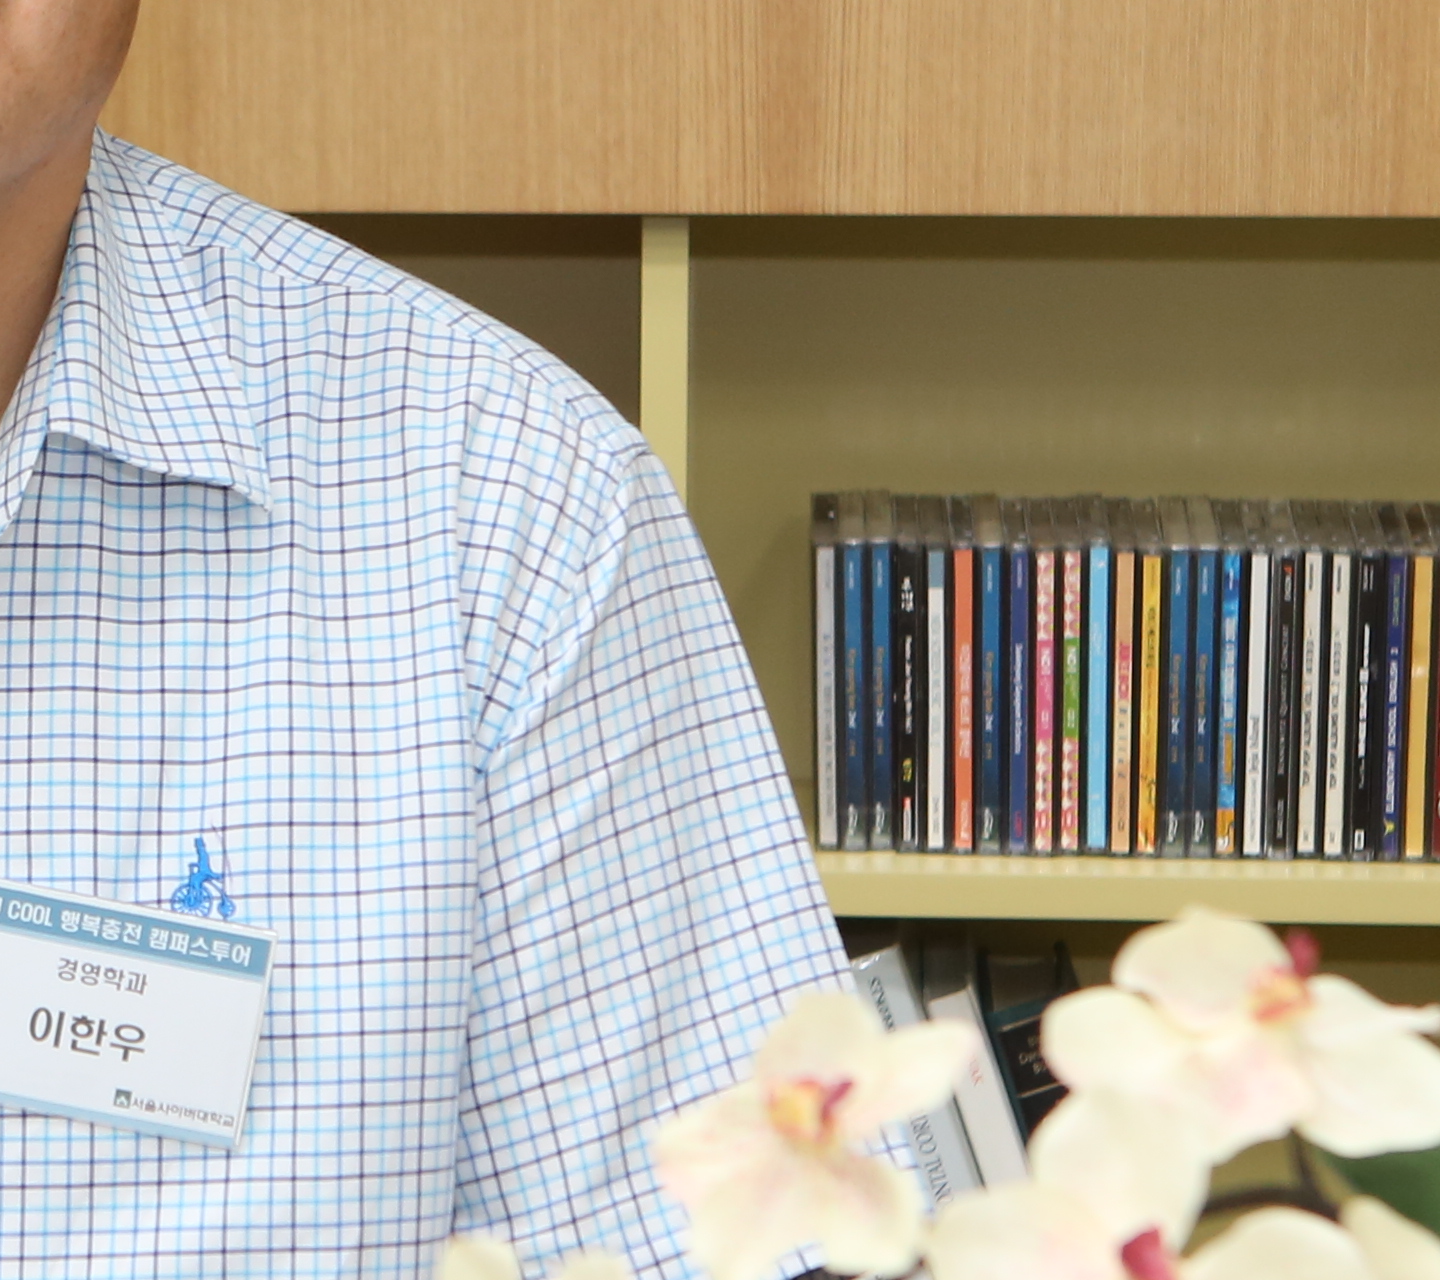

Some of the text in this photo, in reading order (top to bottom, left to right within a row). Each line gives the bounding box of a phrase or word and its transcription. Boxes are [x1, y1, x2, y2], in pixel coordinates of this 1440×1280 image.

[7, 899, 53, 929] COOL
[61, 909, 143, 946] 행복충전
[150, 927, 252, 967] 캠퍼스투어
[56, 957, 148, 996] 경영학과
[28, 1006, 147, 1063] 이한우
[132, 1096, 235, 1128] 서울사이버대학교
[905, 1110, 956, 1206] ONTAL CORT
